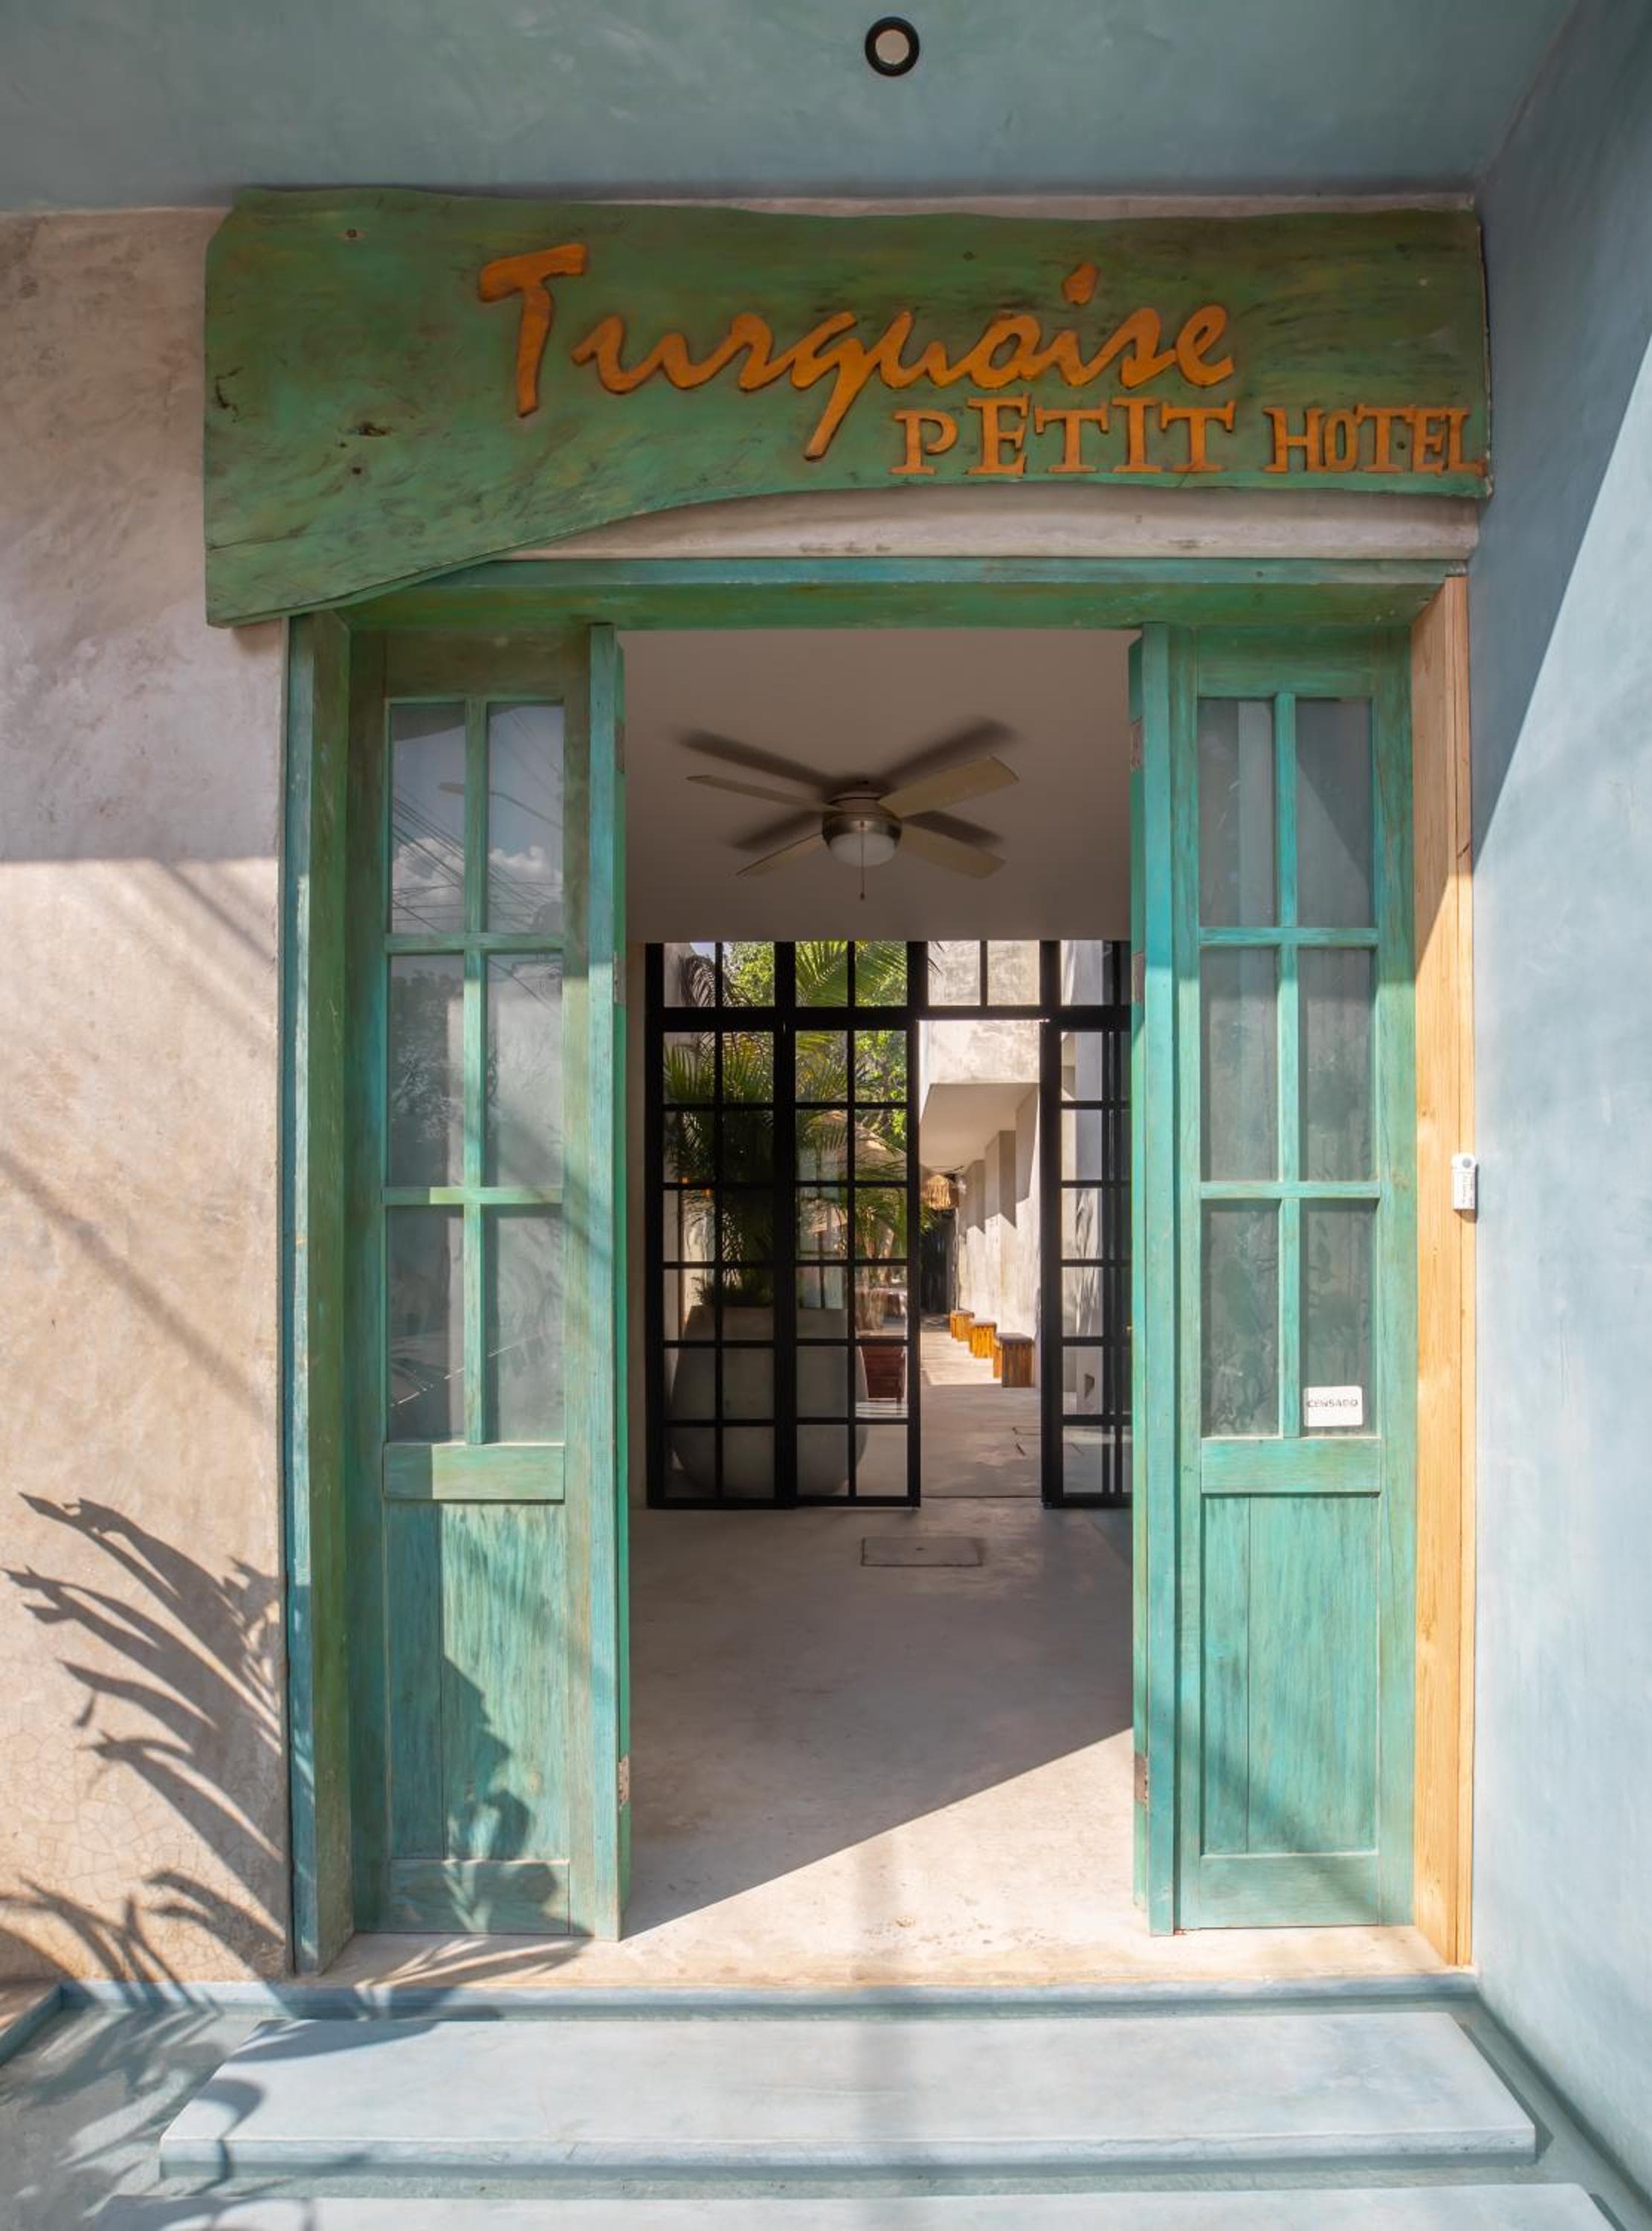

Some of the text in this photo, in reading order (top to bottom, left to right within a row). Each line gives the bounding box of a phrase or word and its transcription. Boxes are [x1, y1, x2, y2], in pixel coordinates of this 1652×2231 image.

[478, 243, 1234, 460] Turquoise
[891, 393, 1485, 476] PETIT HOTEL
